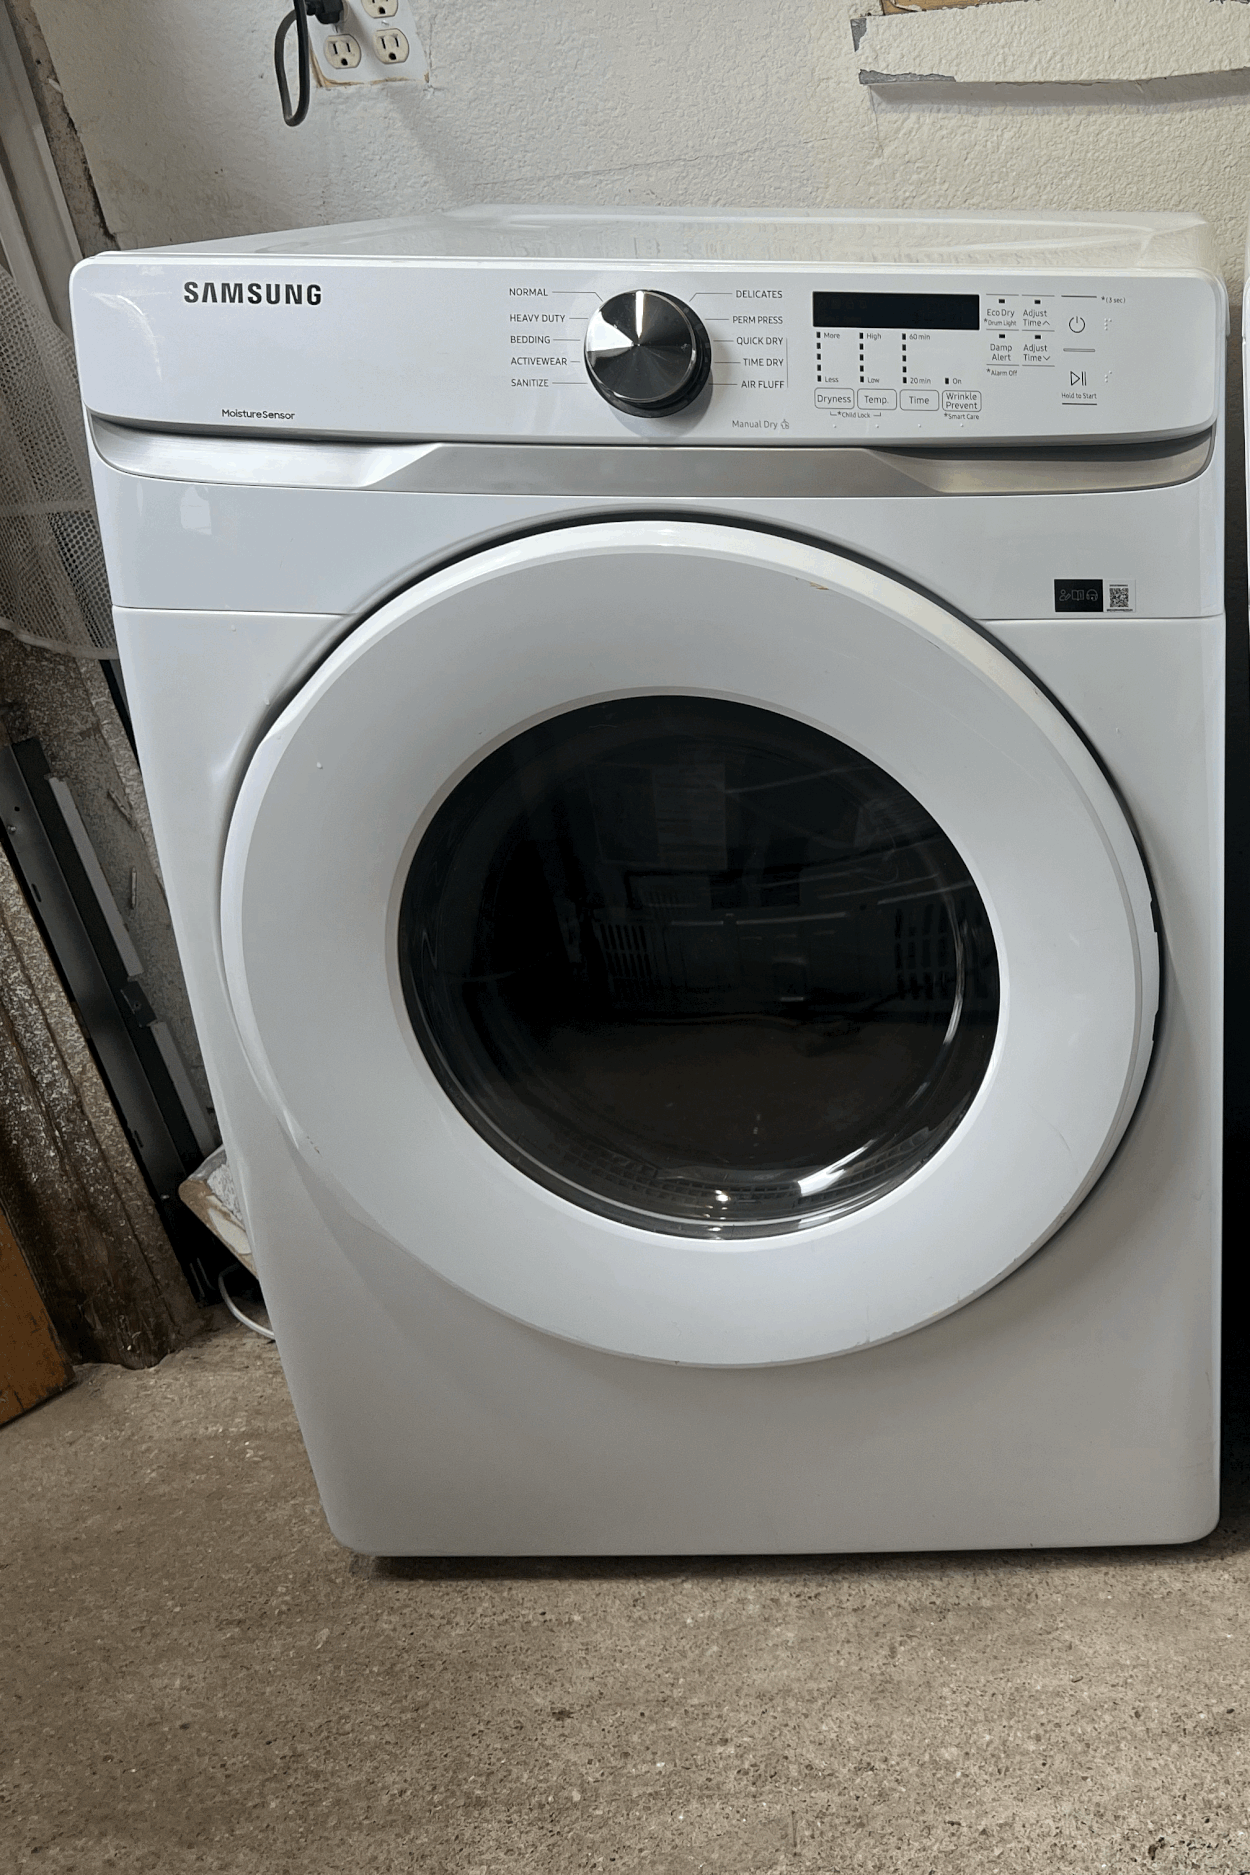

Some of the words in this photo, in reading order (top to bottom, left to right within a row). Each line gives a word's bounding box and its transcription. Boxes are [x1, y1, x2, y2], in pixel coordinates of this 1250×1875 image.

[184, 281, 322, 306] SAMSUNG
[509, 287, 548, 296] NORMAL
[736, 290, 783, 299] DELICATES
[987, 309, 1000, 317] Eco
[1001, 309, 1015, 318] Dry
[1023, 309, 1047, 318] Adjust
[510, 314, 540, 323] HEAVY
[542, 314, 565, 323] DUTY
[732, 316, 756, 324] PERM
[759, 316, 783, 324] PRESS
[1003, 319, 1016, 327] Light
[510, 335, 551, 344] BEDDING
[824, 332, 840, 340] More
[866, 332, 881, 341] High
[919, 333, 930, 341] min
[736, 336, 763, 346] QUICK
[766, 337, 783, 345] DRY
[990, 343, 1013, 353] Damp
[1023, 344, 1047, 353] Adjust
[511, 357, 567, 366] ACTIVEWEAR
[992, 353, 1011, 361] Alert
[1023, 353, 1042, 361] Time
[766, 359, 783, 367] DRY
[511, 379, 549, 387] SANITIZE
[758, 381, 784, 389] FLUFF
[817, 394, 851, 404] Dryness
[864, 395, 889, 405] Temp.
[909, 396, 930, 404] Time
[946, 392, 977, 401] Wrinkle
[946, 401, 978, 410] Prevent
[222, 409, 295, 420] MoistureSensor
[732, 420, 762, 429] Manual
[764, 420, 777, 430] Dry
